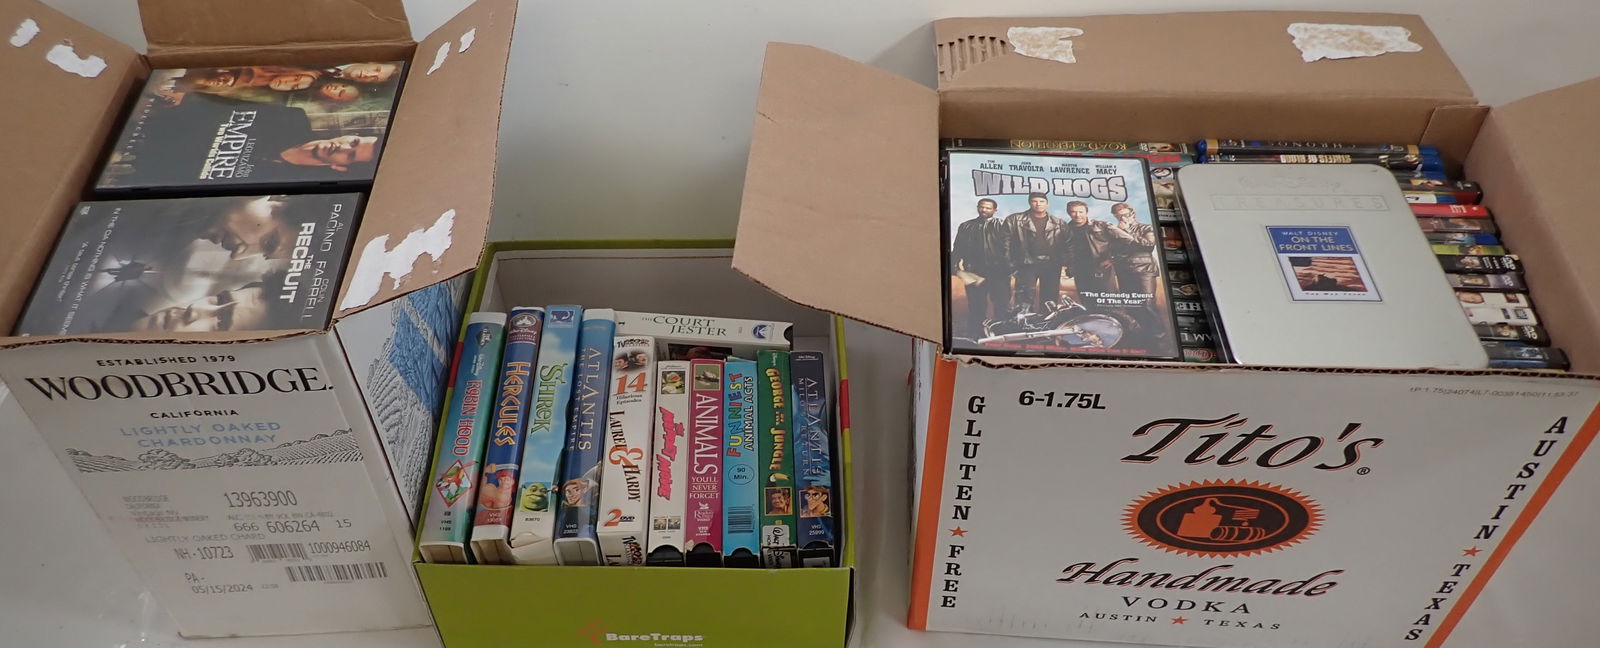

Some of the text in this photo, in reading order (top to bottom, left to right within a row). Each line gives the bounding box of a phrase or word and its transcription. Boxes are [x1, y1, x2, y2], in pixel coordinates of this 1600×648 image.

[207, 110, 256, 180] EMPIRE
[1010, 139, 1076, 150] PERDITION
[1088, 141, 1128, 151] ROAD
[1050, 166, 1090, 174] LAWRENCE
[972, 169, 1128, 202] WILD HOGS
[319, 203, 342, 253] PACINO
[1312, 236, 1335, 244] THE
[1321, 244, 1354, 252] LINES
[279, 222, 316, 303] RECRUIT
[303, 254, 314, 270] THE
[302, 260, 327, 319] FARRELL
[653, 316, 715, 328] COURT
[670, 325, 727, 336] JESTER
[96, 355, 236, 367] ESTABLISHED 1979
[612, 372, 648, 396] 14
[765, 368, 785, 409] GEORGE
[461, 380, 483, 415] ROBIN
[494, 361, 531, 447] HERCULES
[530, 362, 568, 436] SHREK
[578, 347, 602, 450] ATLANTIS
[1018, 390, 1107, 410] 6-1.75L
[150, 409, 240, 419] CALIFORNIA
[726, 373, 743, 457] FUNNIEST
[743, 376, 754, 451] ANIMAL ACTS
[806, 377, 823, 474] ATLANTIS
[120, 421, 281, 437] LIGHTLY OAKED
[137, 434, 279, 448] CHARDONNAY
[453, 419, 475, 457] HOOD
[609, 410, 628, 450] LAUREL
[693, 393, 719, 475] ANIMALS
[769, 428, 787, 471] JUNGLE
[1120, 412, 1385, 471] Tito's
[622, 464, 641, 502] HARDY
[224, 490, 298, 508] 13963900
[940, 396, 986, 609] GLUTEN FREE
[233, 522, 260, 532] 666
[266, 520, 320, 533] 606264
[603, 508, 623, 527] 2
[1404, 416, 1568, 641] AUSTIN TEXAS
[230, 533, 265, 541] CHARD
[308, 540, 371, 554] 1000946084
[1056, 557, 1345, 597] Handmade
[191, 584, 254, 595] 05/15/2024
[1121, 596, 1252, 614] VODKA
[1080, 612, 1282, 630] AUSTIN TEXAS
[605, 633, 703, 642] BareTraps
